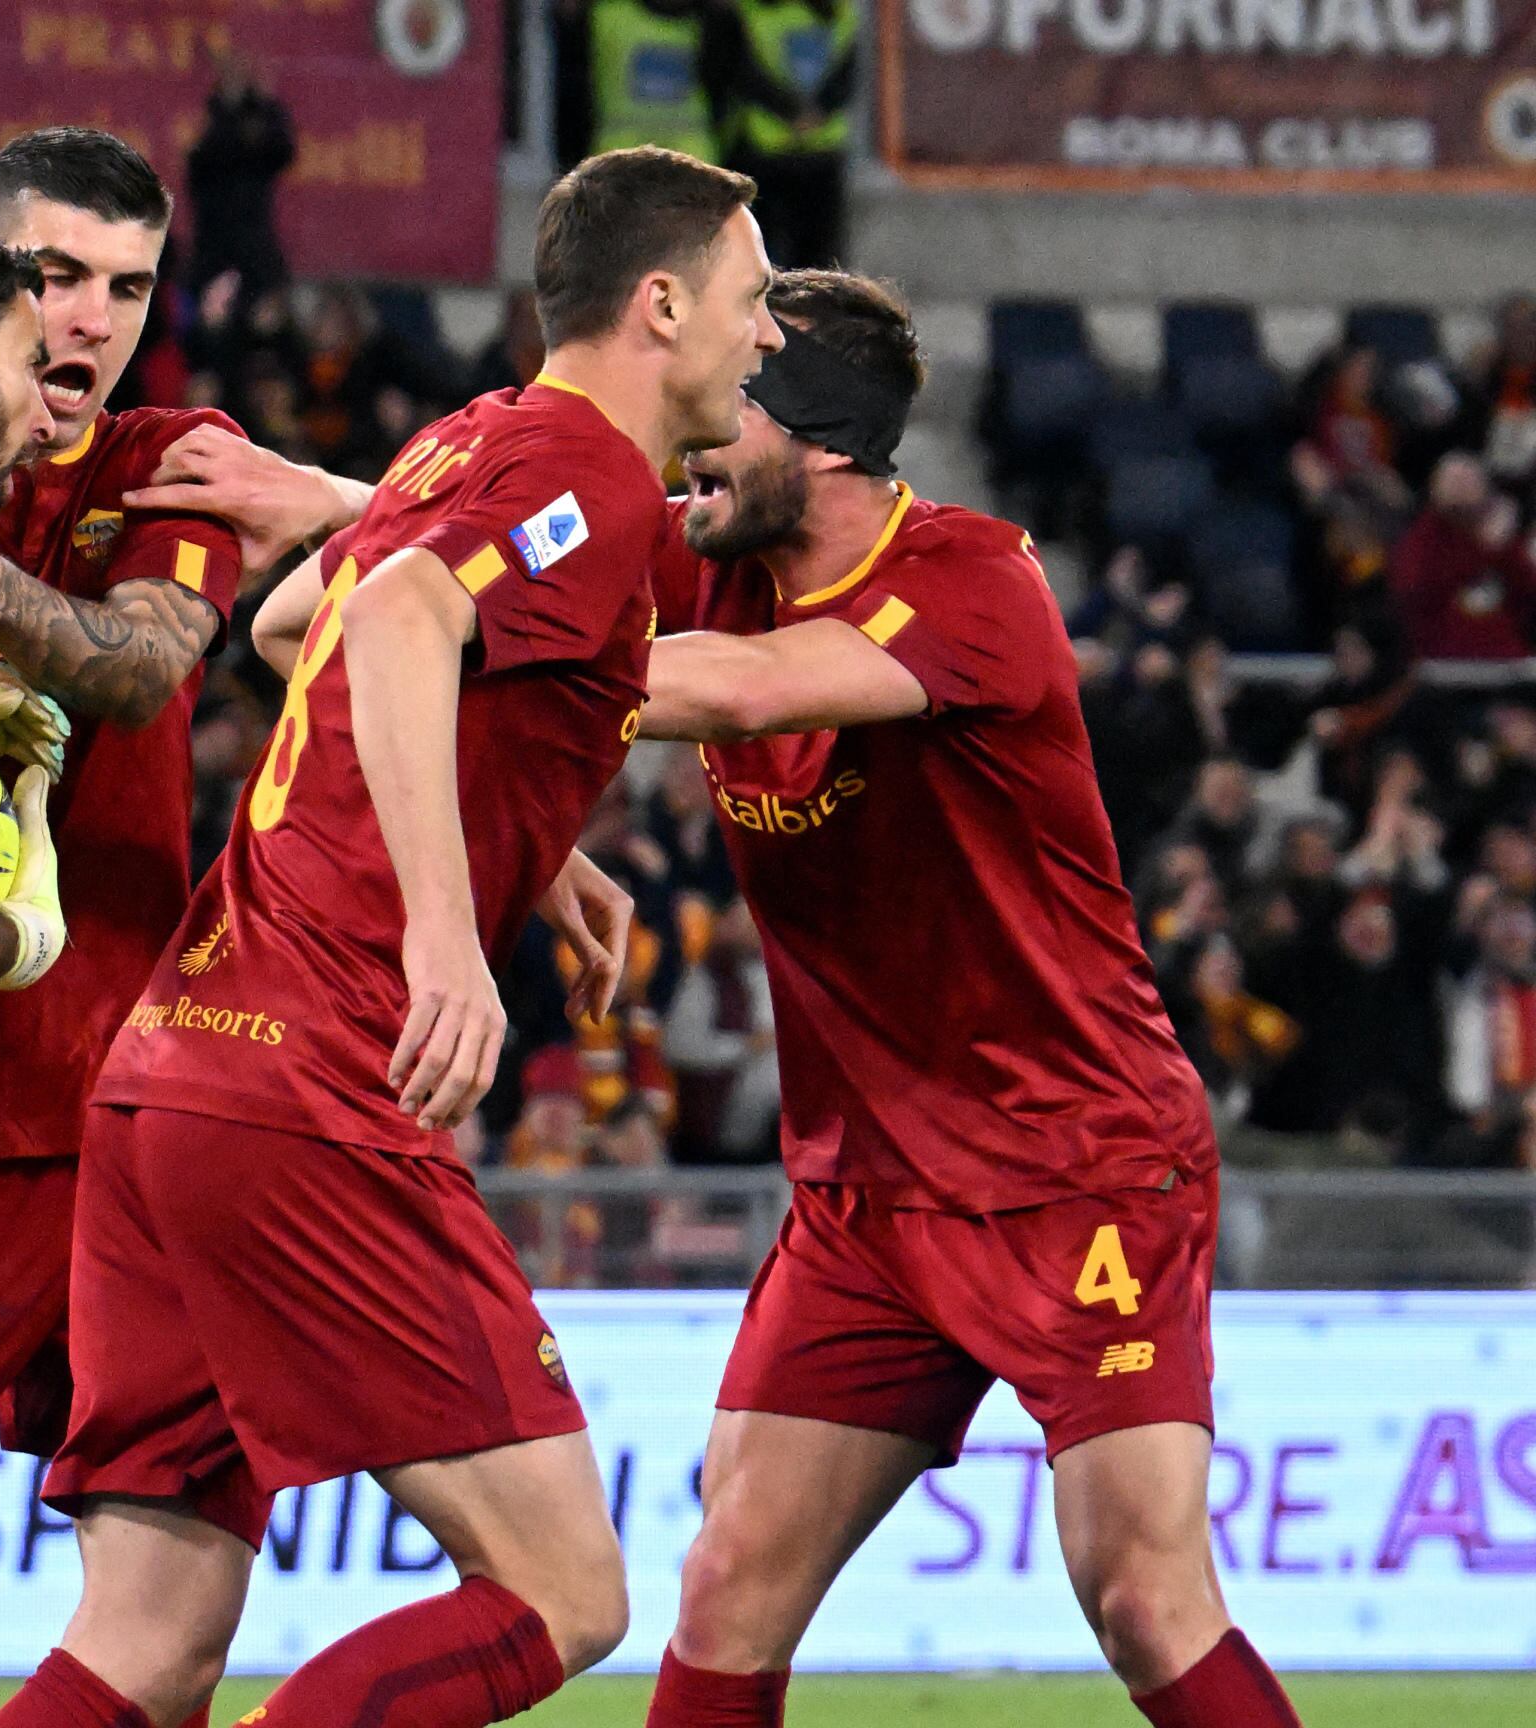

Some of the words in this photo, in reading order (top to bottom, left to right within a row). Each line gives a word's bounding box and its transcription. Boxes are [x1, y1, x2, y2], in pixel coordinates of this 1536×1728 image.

[1065, 116, 1248, 166] ROMA
[1263, 118, 1435, 167] CLUB
[524, 545, 539, 571] TIM
[169, 996, 287, 1046] Resorts
[1074, 1223, 1142, 1316] 4
